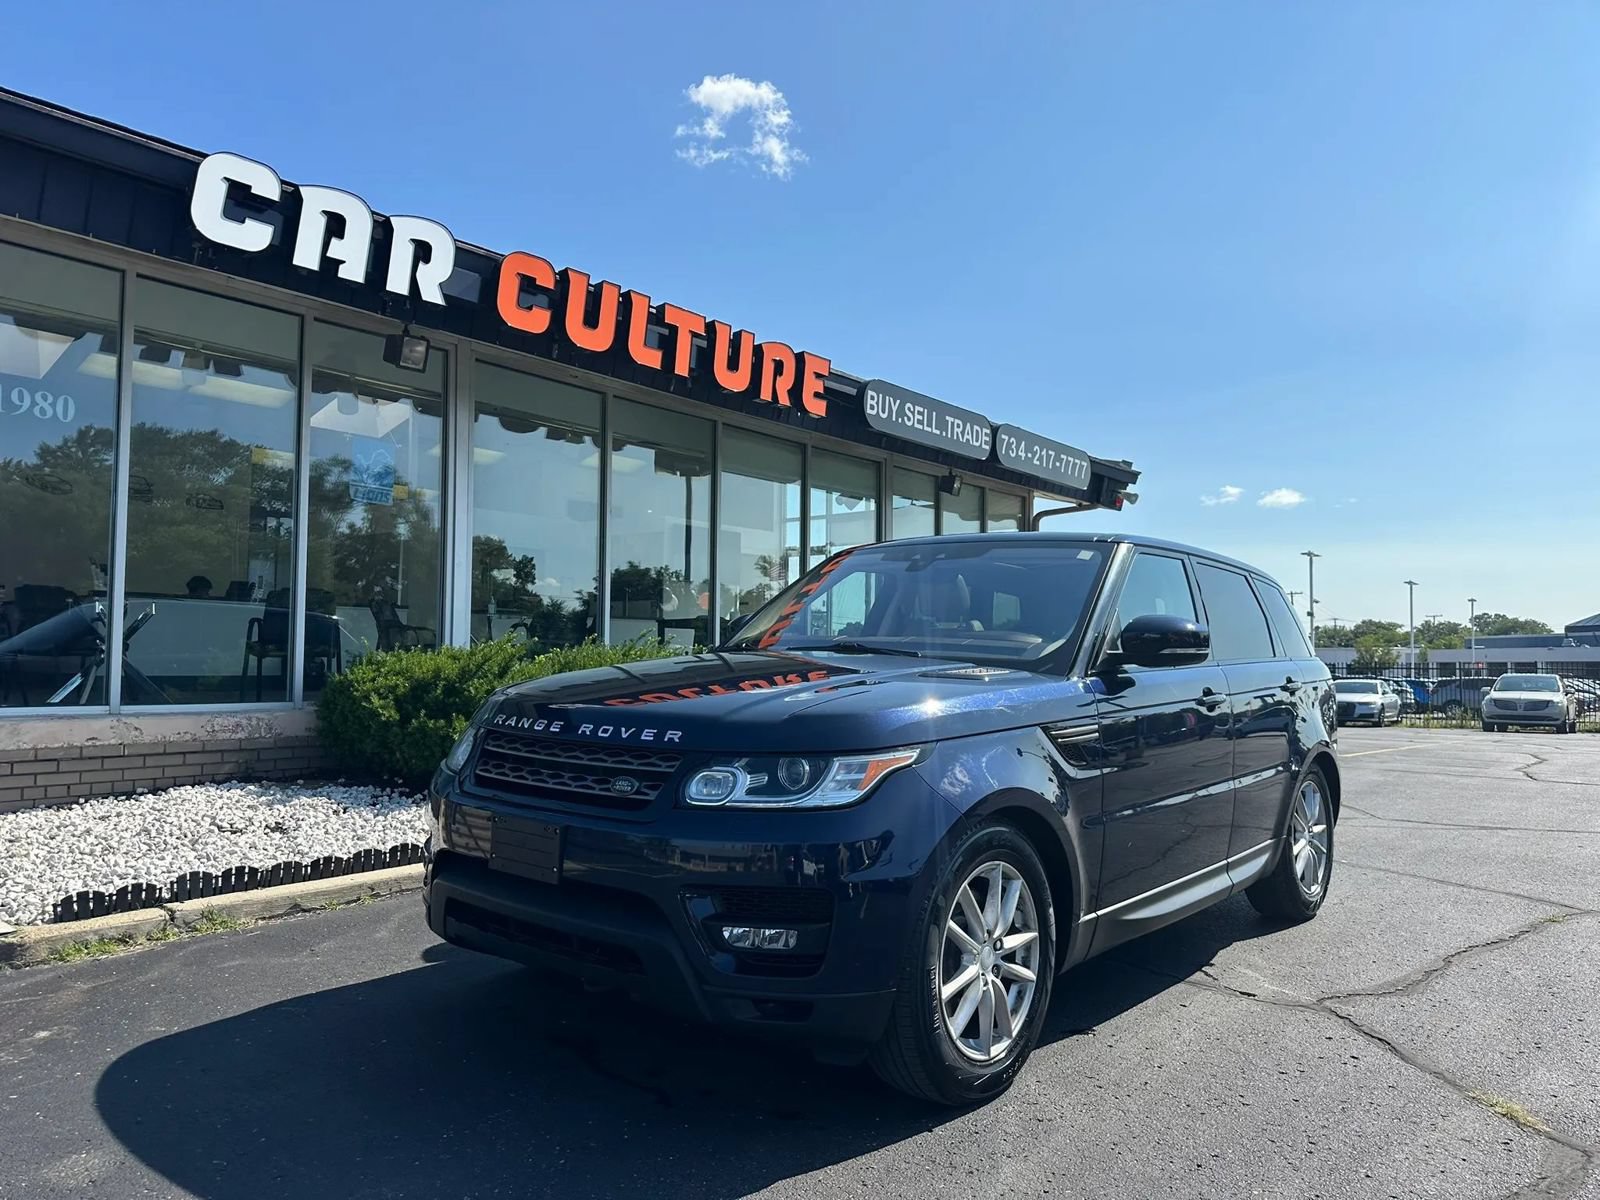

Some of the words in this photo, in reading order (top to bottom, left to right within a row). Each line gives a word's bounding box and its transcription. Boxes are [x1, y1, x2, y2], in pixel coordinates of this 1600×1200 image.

[190, 152, 457, 306] CAR
[496, 251, 832, 418] CULTURE
[1000, 433, 1088, 481] 734-217-7777
[494, 714, 565, 732] RANGE
[578, 723, 684, 743] ROVER
